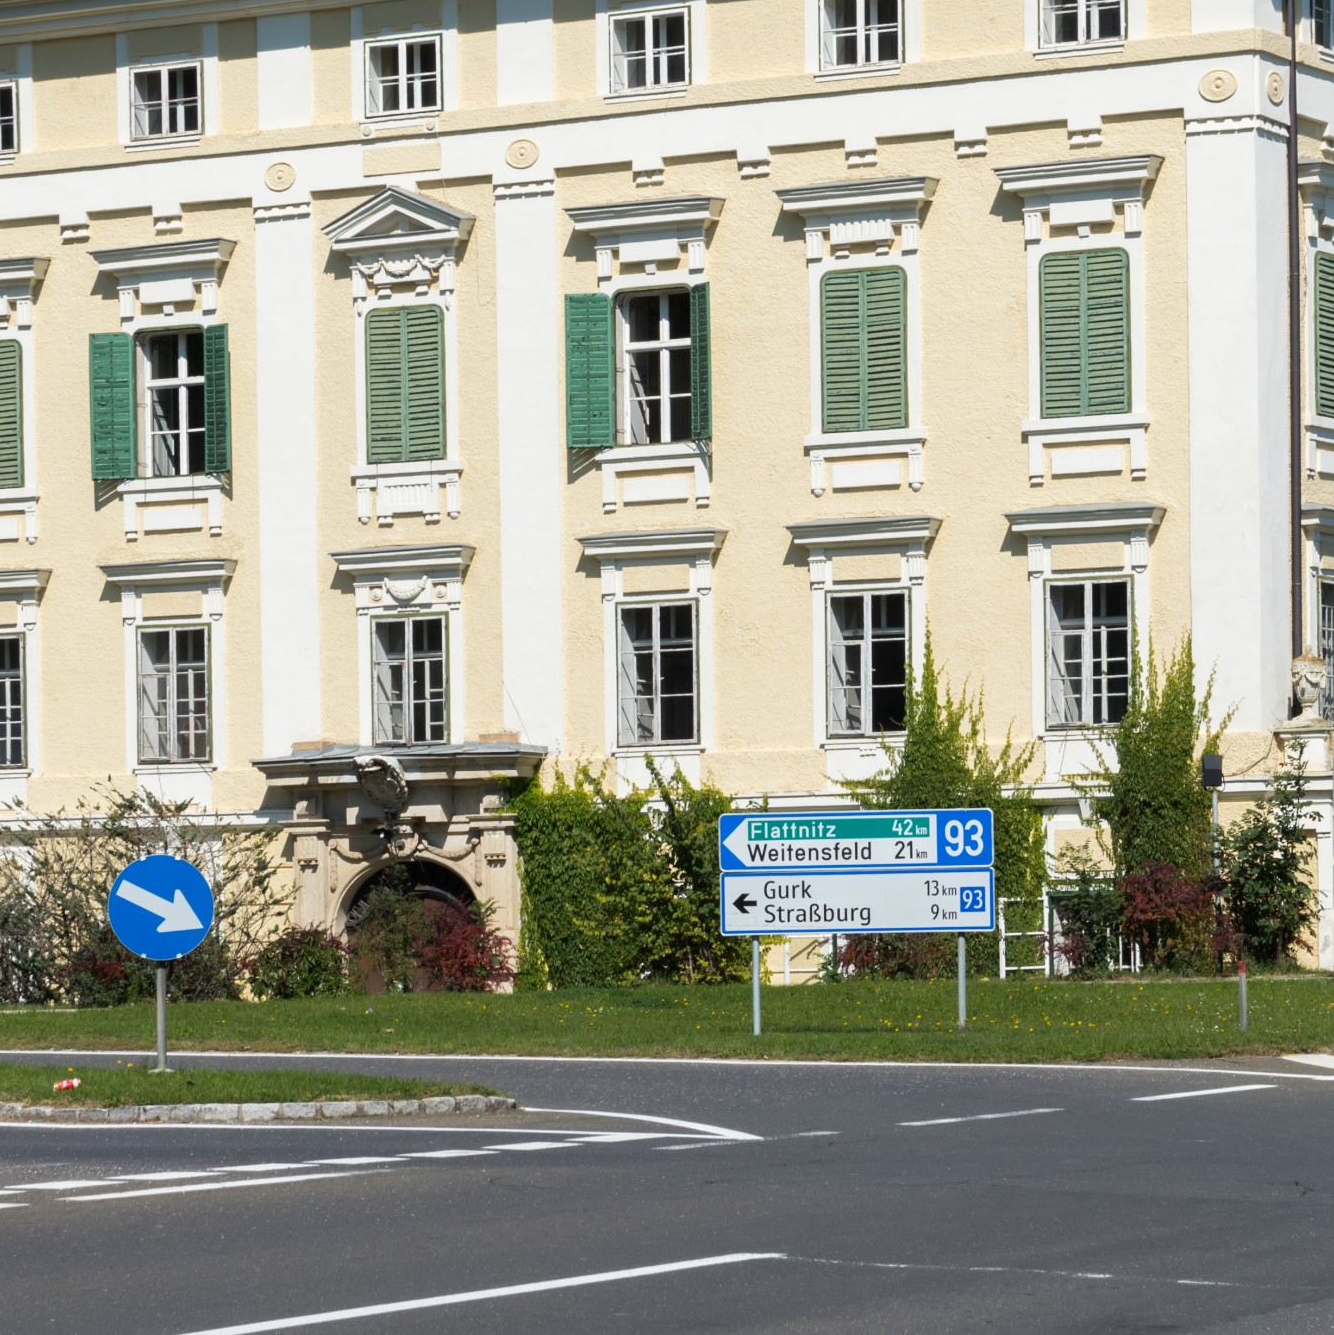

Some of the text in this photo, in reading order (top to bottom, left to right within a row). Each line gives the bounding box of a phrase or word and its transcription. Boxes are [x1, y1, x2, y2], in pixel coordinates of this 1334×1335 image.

[750, 819, 927, 839] Flattnitz 42 km
[945, 819, 984, 857] 93
[747, 841, 928, 862] Weitensfeld 21 km
[763, 880, 957, 899] Gurk 13 km
[962, 889, 983, 909] 93
[764, 903, 957, 926] Straßburg 9 km
